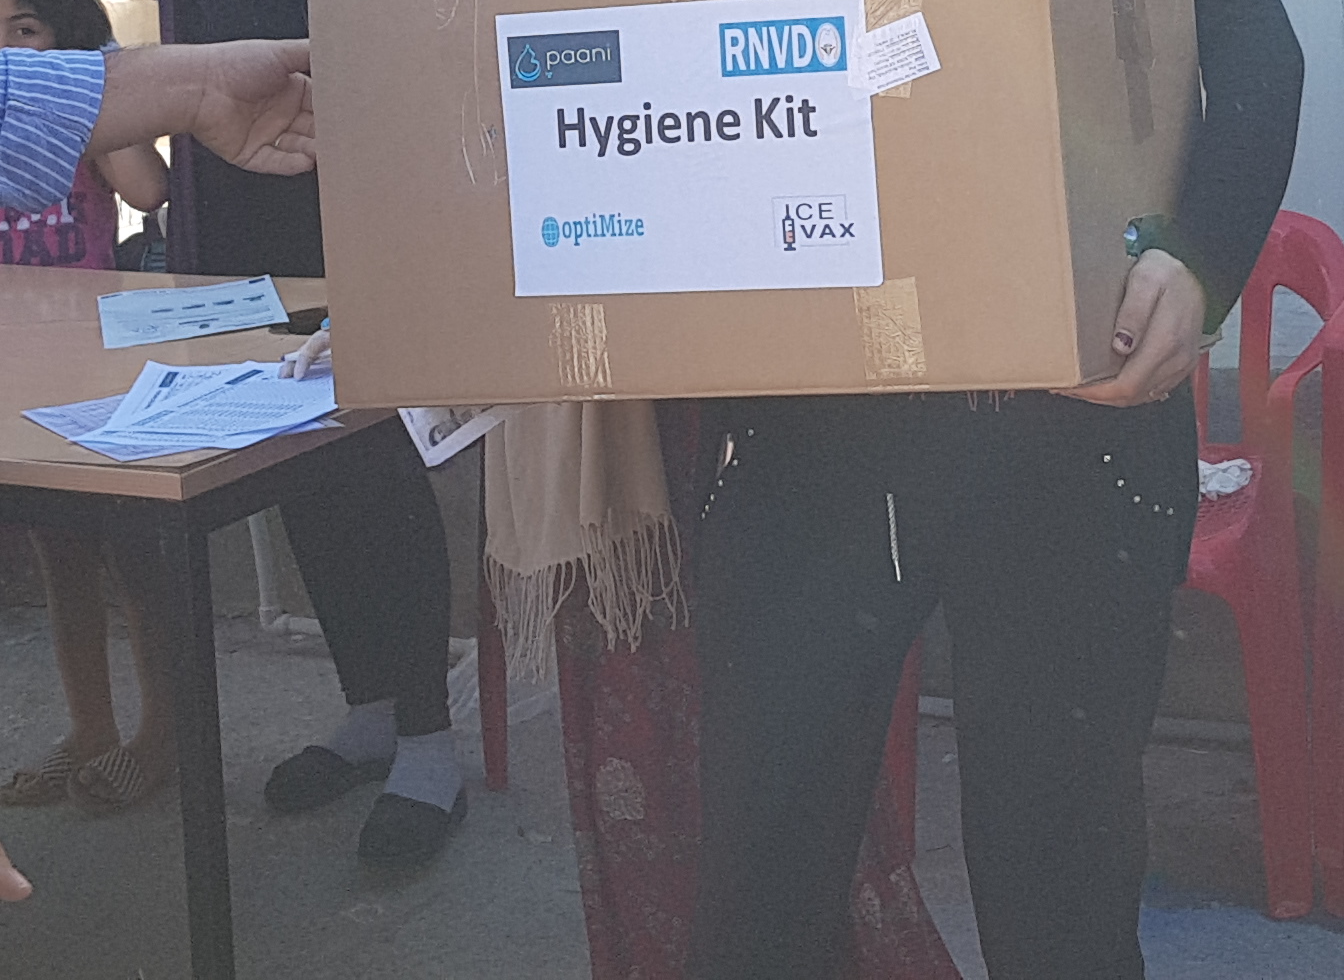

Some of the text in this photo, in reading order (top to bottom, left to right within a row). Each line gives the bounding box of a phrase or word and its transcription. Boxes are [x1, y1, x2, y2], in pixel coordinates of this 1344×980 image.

[546, 44, 611, 69] paani
[557, 95, 818, 157] Hygiene Kit
[562, 213, 645, 246] optiMize
[801, 223, 856, 239] VAX
